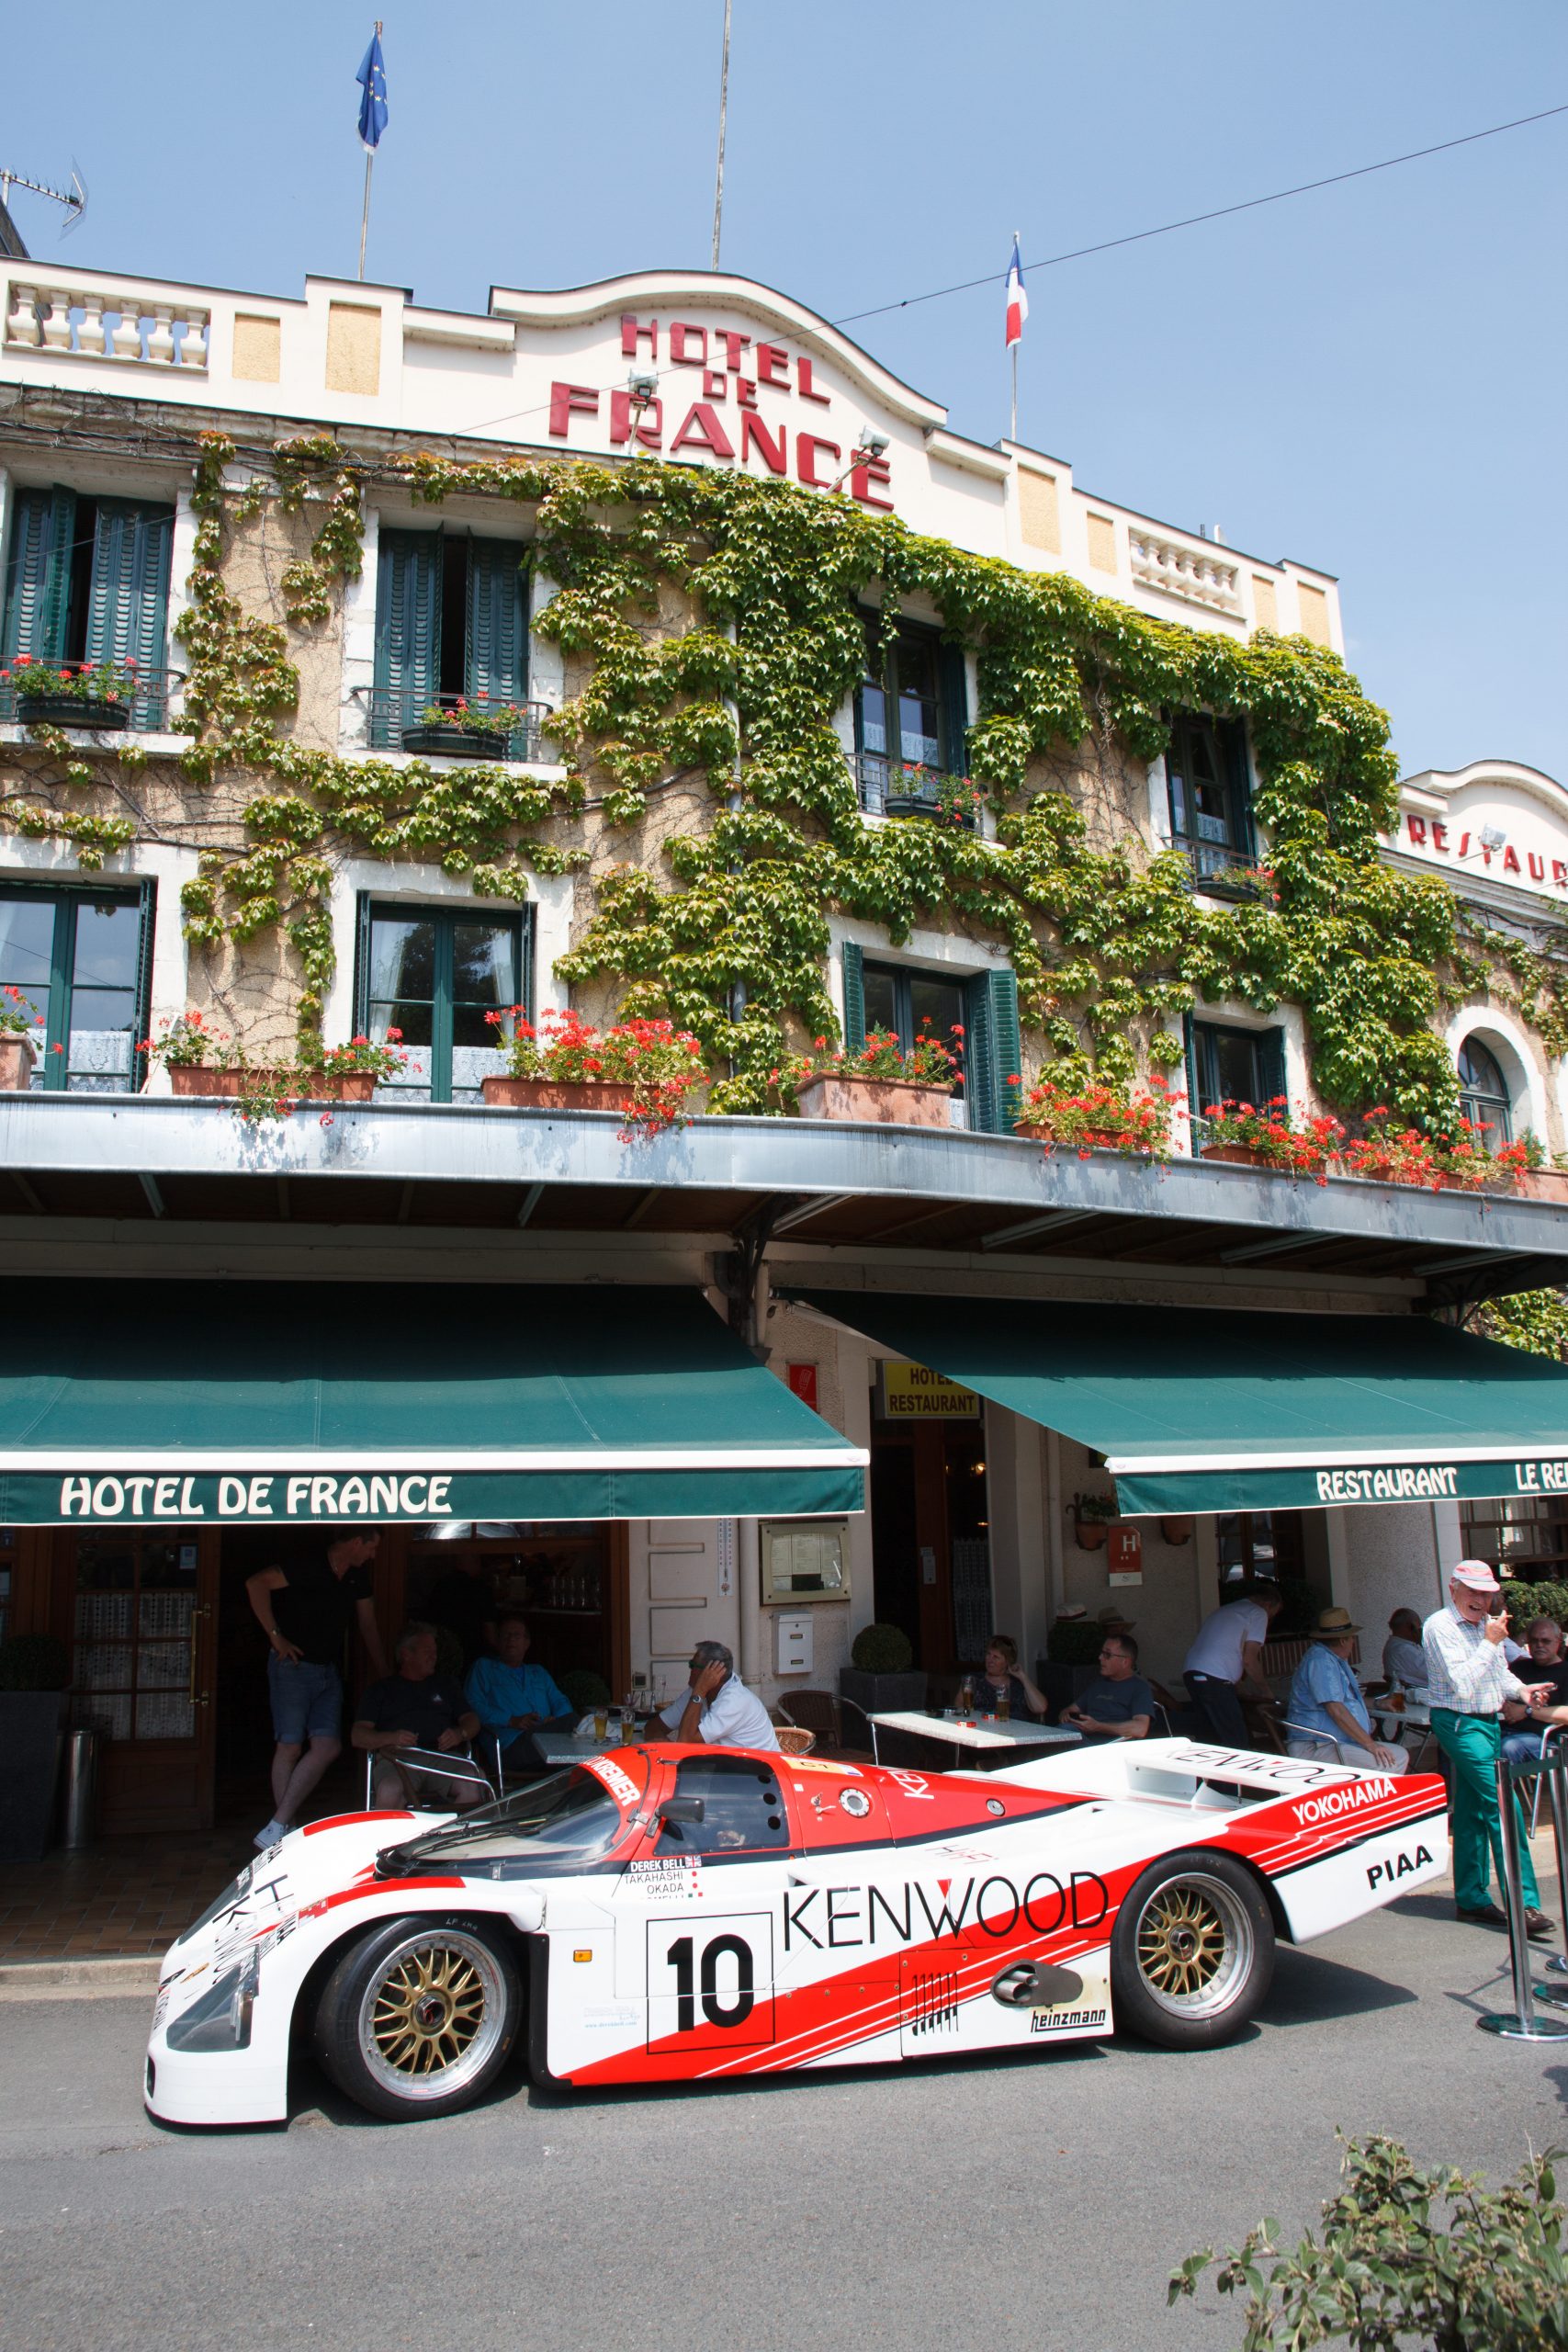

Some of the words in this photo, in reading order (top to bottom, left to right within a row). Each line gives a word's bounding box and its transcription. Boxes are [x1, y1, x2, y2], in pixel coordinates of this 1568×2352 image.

[621, 315, 830, 404] HOTEL
[703, 368, 758, 410] DE
[549, 380, 895, 512] FRANCE
[888, 1394, 976, 1413] RESTAURANT
[61, 1476, 204, 1516] HOTEL
[218, 1476, 274, 1515] DE
[287, 1476, 453, 1515] FRANCE
[1315, 1466, 1458, 1501] RESTAURANT
[1515, 1464, 1540, 1490] LE
[1122, 1534, 1136, 1552] H
[590, 1758, 641, 1807] KREMER
[1292, 1777, 1398, 1826] YOKOHAMA
[625, 1871, 684, 1884] TAKAHASHI
[630, 1860, 661, 1873] DEREK
[662, 1858, 685, 1871] BELL
[1366, 1844, 1434, 1891] PIAA
[647, 1883, 684, 1894] OKADA
[784, 1871, 1109, 1952] KENWOOD
[667, 1933, 754, 2033] 10
[1031, 2009, 1107, 2033] heinzmann
